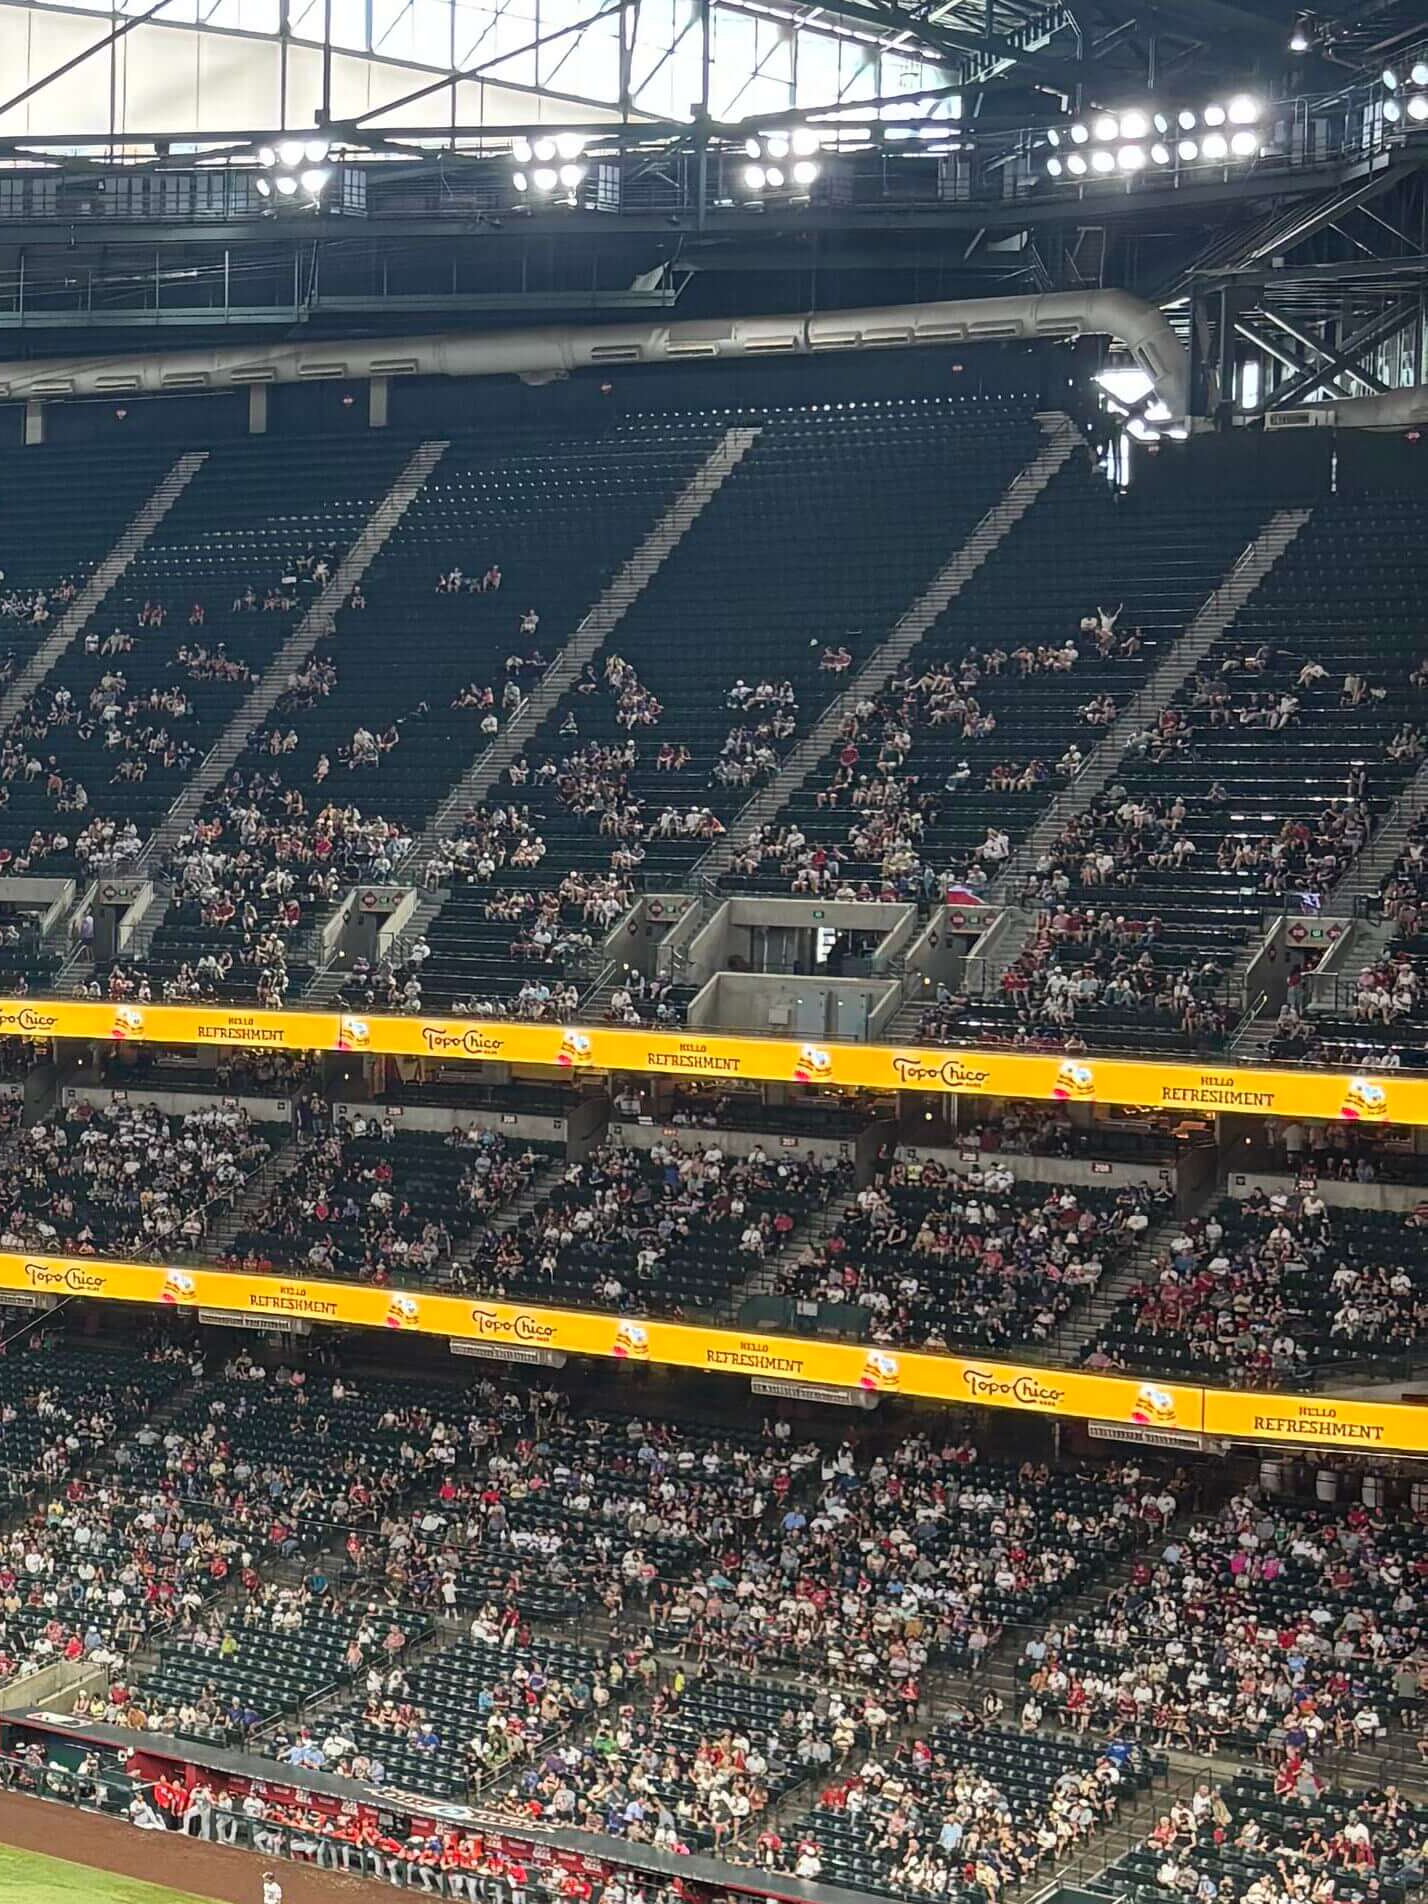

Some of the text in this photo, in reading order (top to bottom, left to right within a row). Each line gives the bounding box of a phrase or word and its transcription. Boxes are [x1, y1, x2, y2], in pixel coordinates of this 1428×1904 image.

[17, 1009, 59, 1030] Chico
[422, 1028, 505, 1054] Topo Chico
[893, 1057, 990, 1086] Topo Chico
[1201, 1076, 1234, 1086] HELLO
[24, 1263, 108, 1291] Topo Chico
[472, 1309, 558, 1339] Topo Chico
[962, 1368, 1065, 1404] Topo Chico
[1300, 1406, 1337, 1418] HELLO
